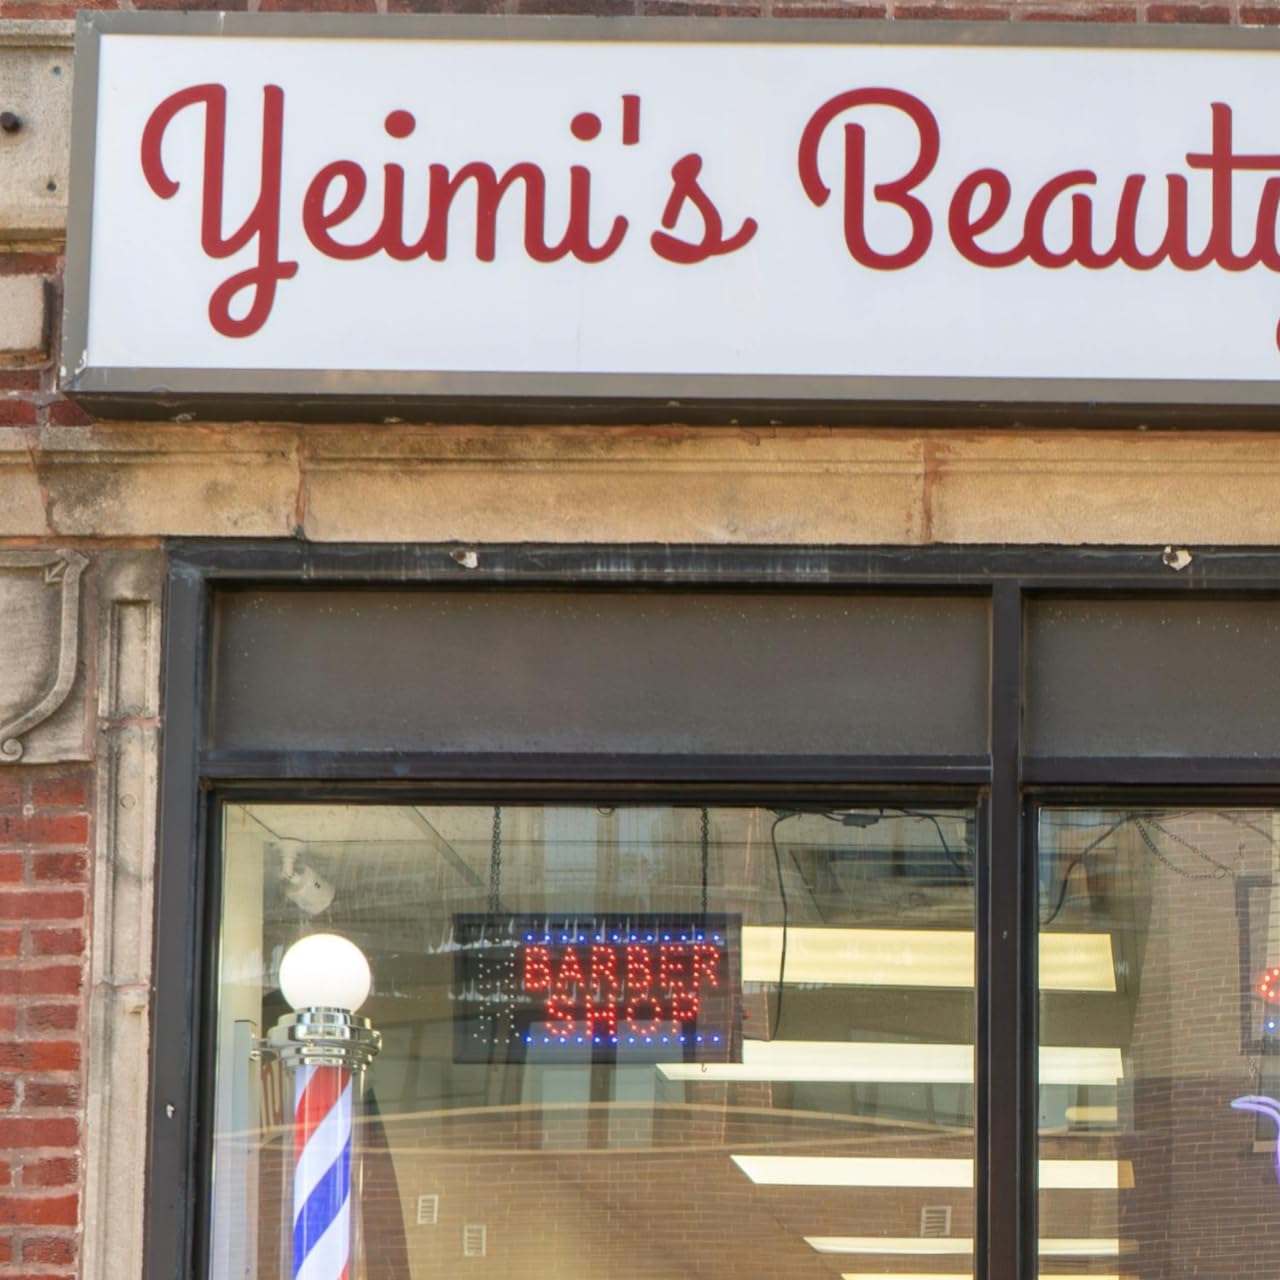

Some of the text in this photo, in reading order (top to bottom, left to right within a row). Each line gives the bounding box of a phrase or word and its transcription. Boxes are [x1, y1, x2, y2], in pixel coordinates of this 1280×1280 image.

[140, 83, 758, 338] Yeimi's
[524, 944, 720, 990] BARBER
[545, 993, 700, 1037] SHOP
